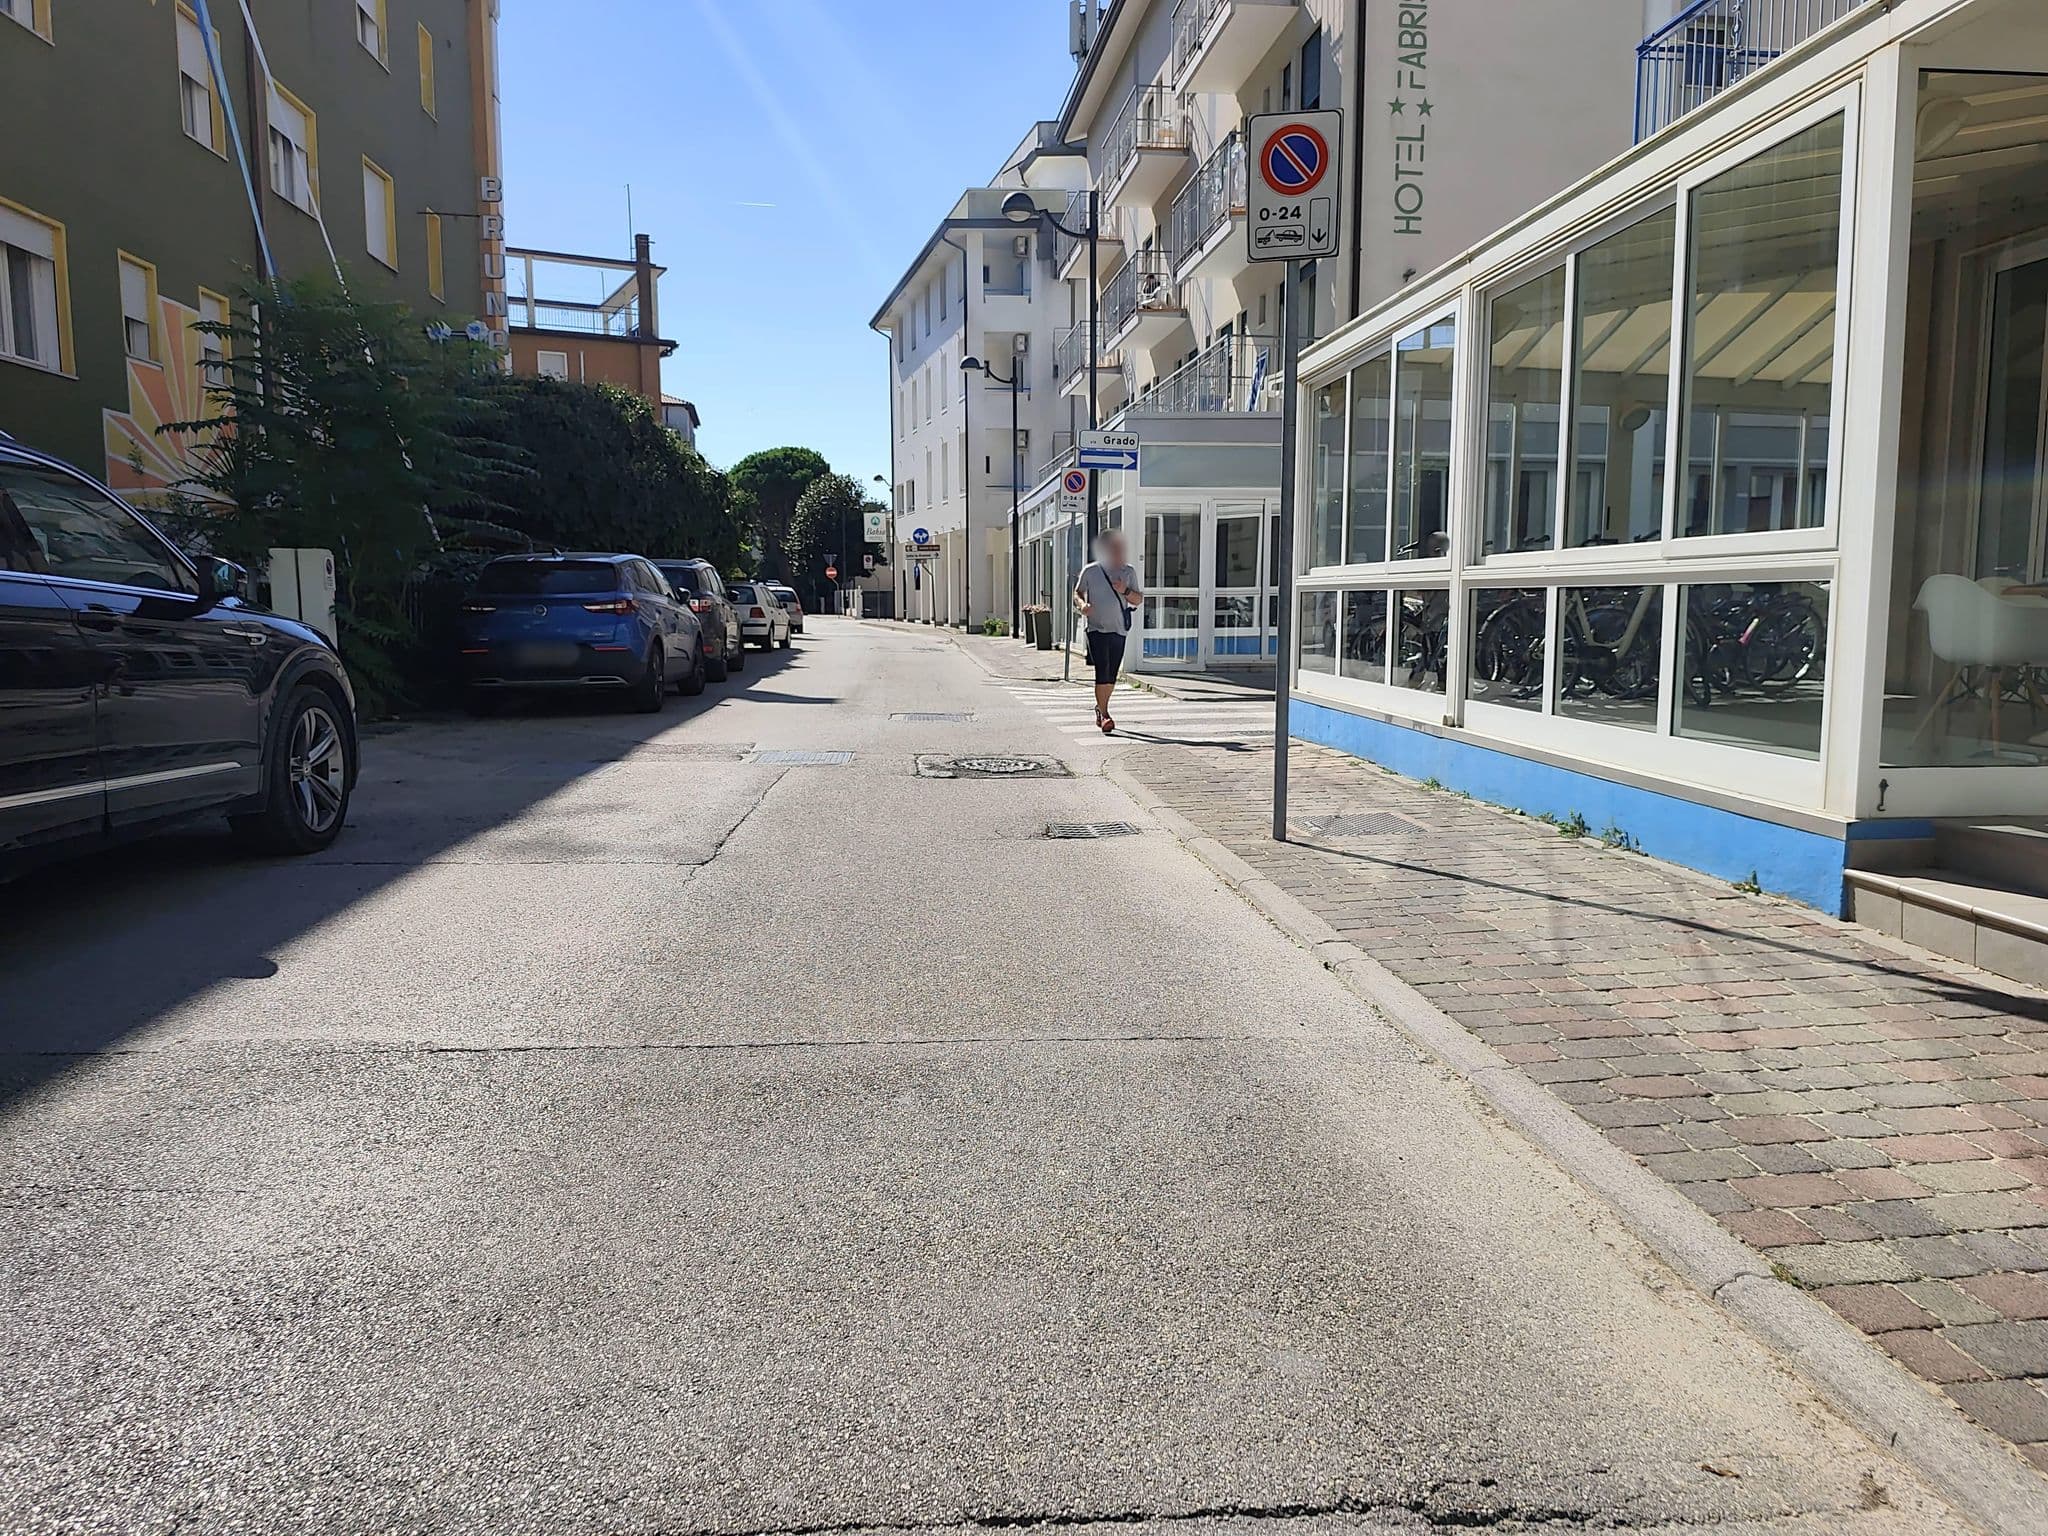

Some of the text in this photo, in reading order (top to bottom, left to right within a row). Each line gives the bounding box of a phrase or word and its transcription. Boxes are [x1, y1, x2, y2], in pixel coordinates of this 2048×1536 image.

[1397, 0, 1428, 90] FABRI
[1393, 124, 1425, 235] HOTEL
[1259, 206, 1302, 220] 0-24
[1103, 435, 1136, 446] Grado
